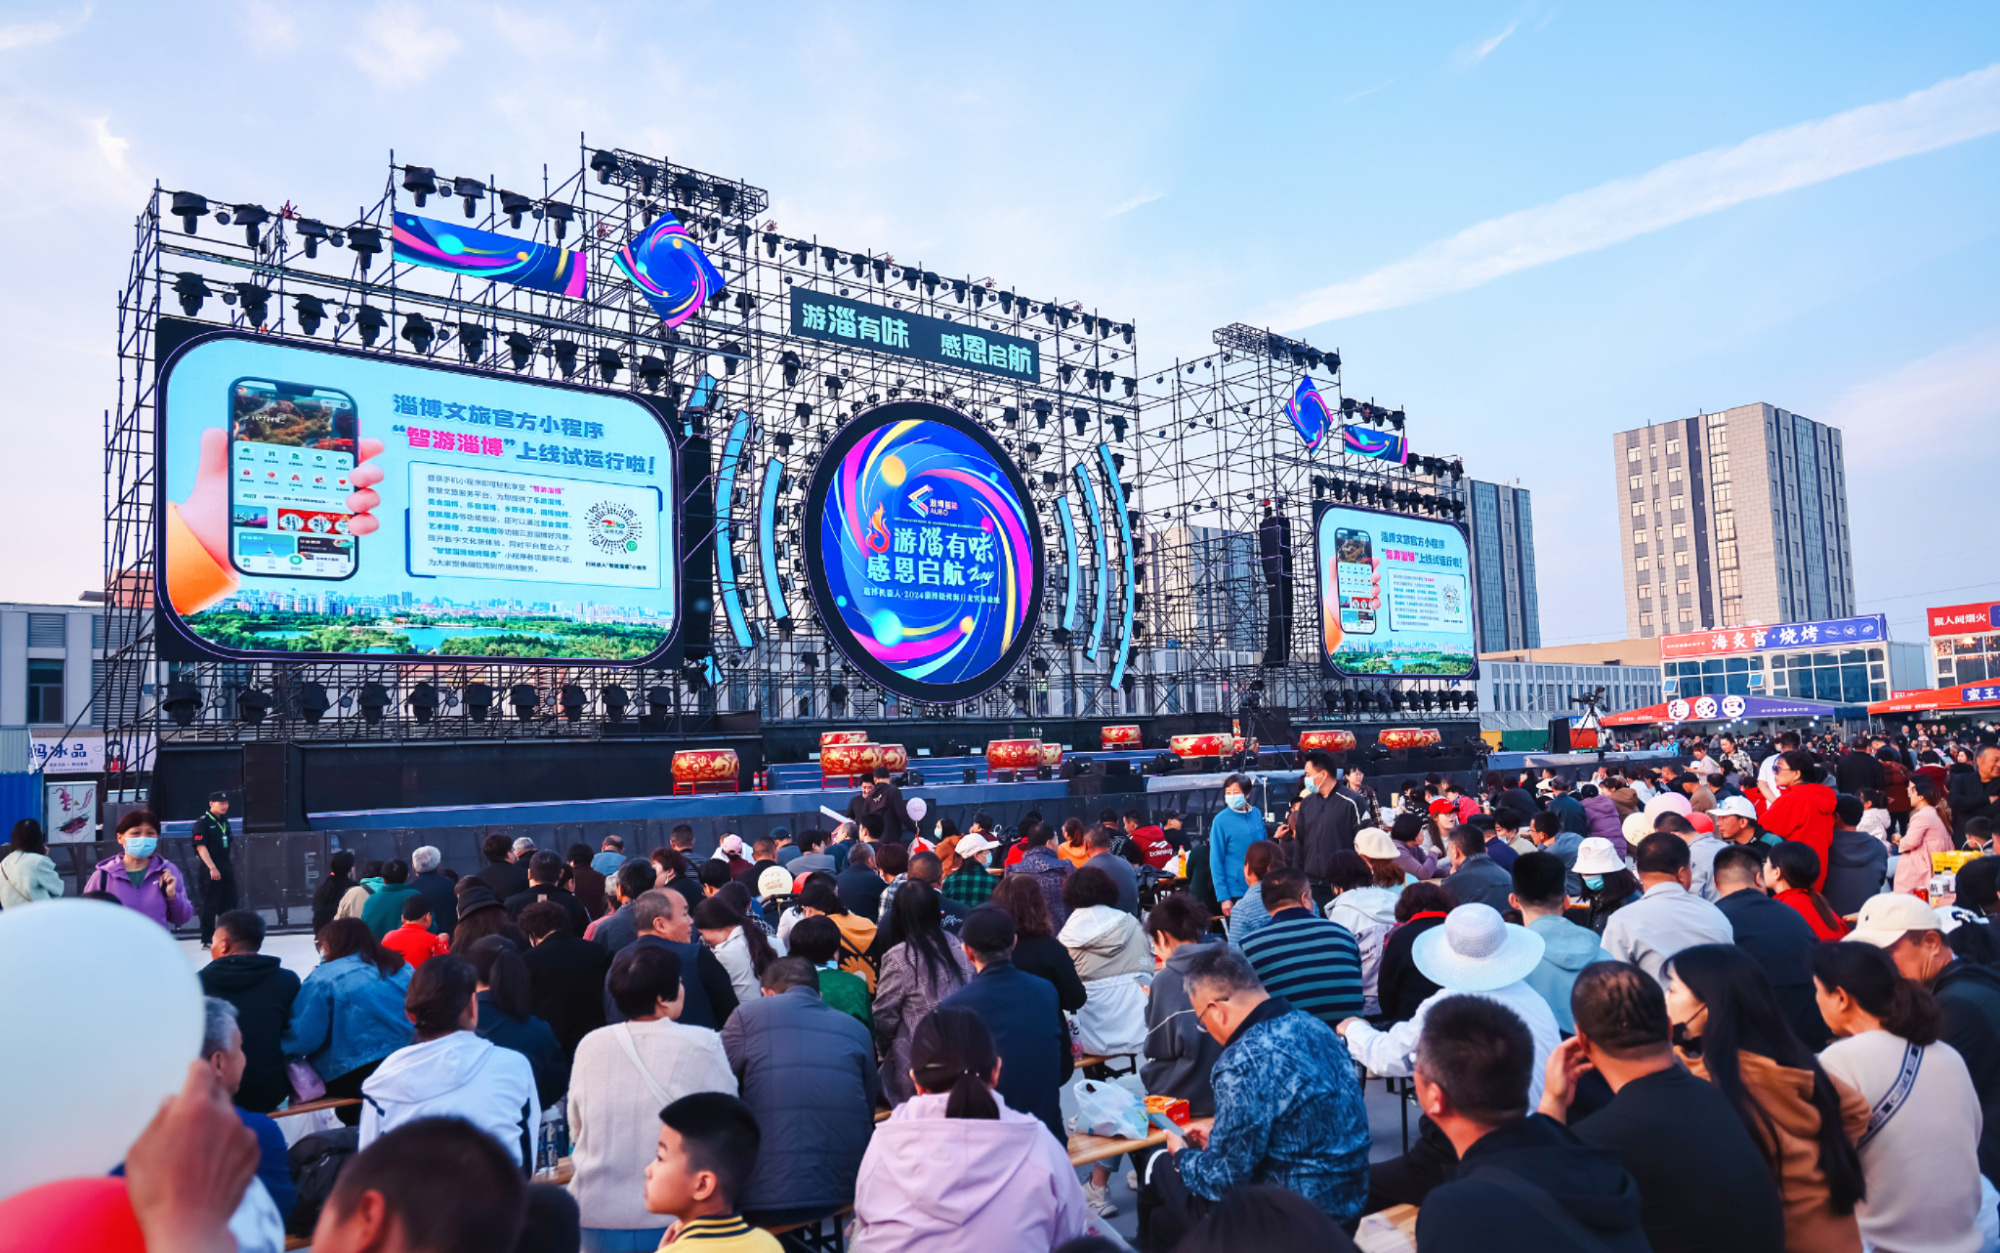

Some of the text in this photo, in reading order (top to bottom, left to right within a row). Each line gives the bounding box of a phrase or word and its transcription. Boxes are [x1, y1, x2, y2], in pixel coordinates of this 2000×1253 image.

[801, 302, 1033, 375] 游淄有味 感恩启航
[392, 394, 604, 439] 淄博文旅官方小程序
[893, 526, 994, 563] 游淄有味
[1381, 531, 1445, 549] 淄博文旅官方小程序
[866, 555, 966, 587] 感恩启航
